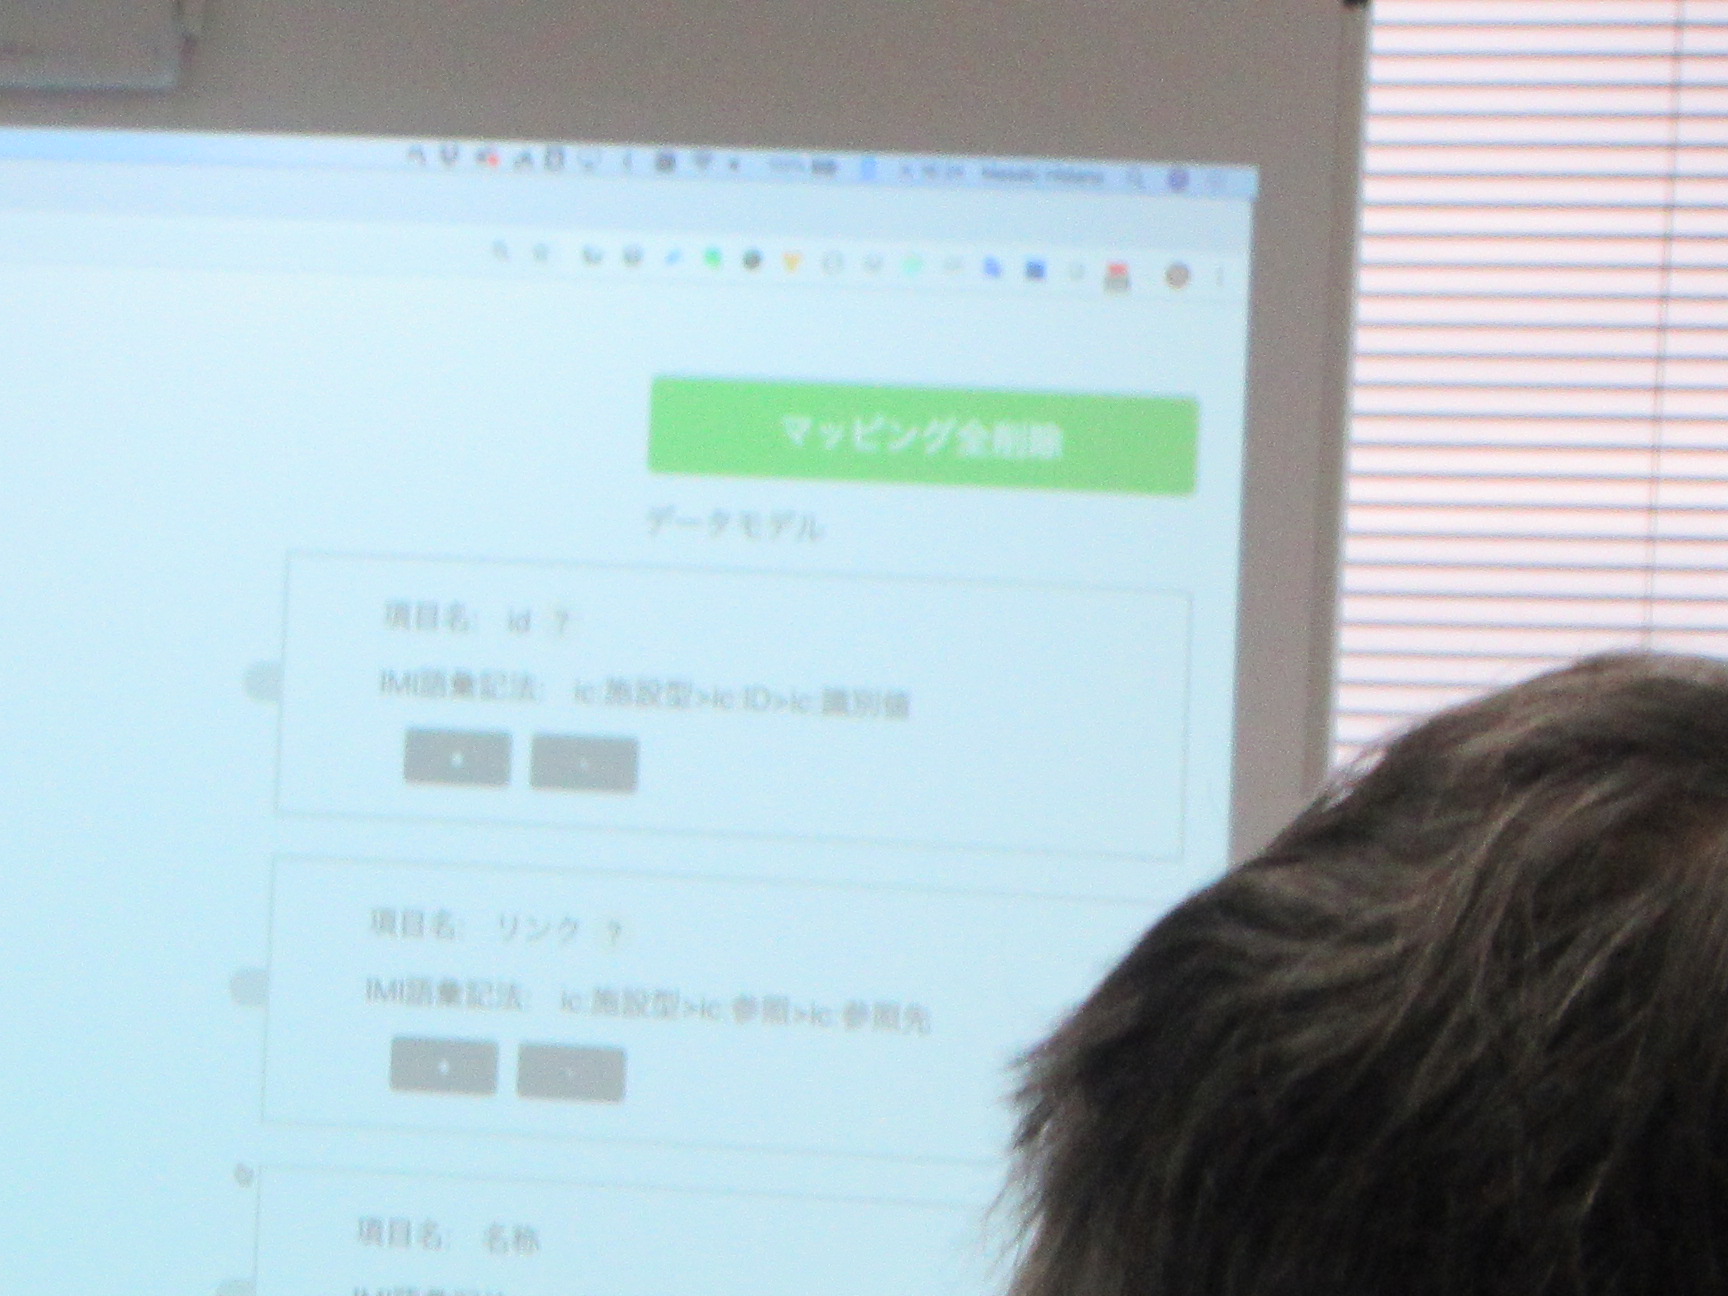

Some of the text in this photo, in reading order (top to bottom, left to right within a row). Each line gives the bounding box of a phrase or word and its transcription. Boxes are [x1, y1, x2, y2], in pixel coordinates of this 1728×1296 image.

[779, 411, 1064, 462] マッピング全削除
[645, 503, 828, 548] データモデル
[494, 911, 582, 948] リンク
[480, 1219, 544, 1258] 名称
